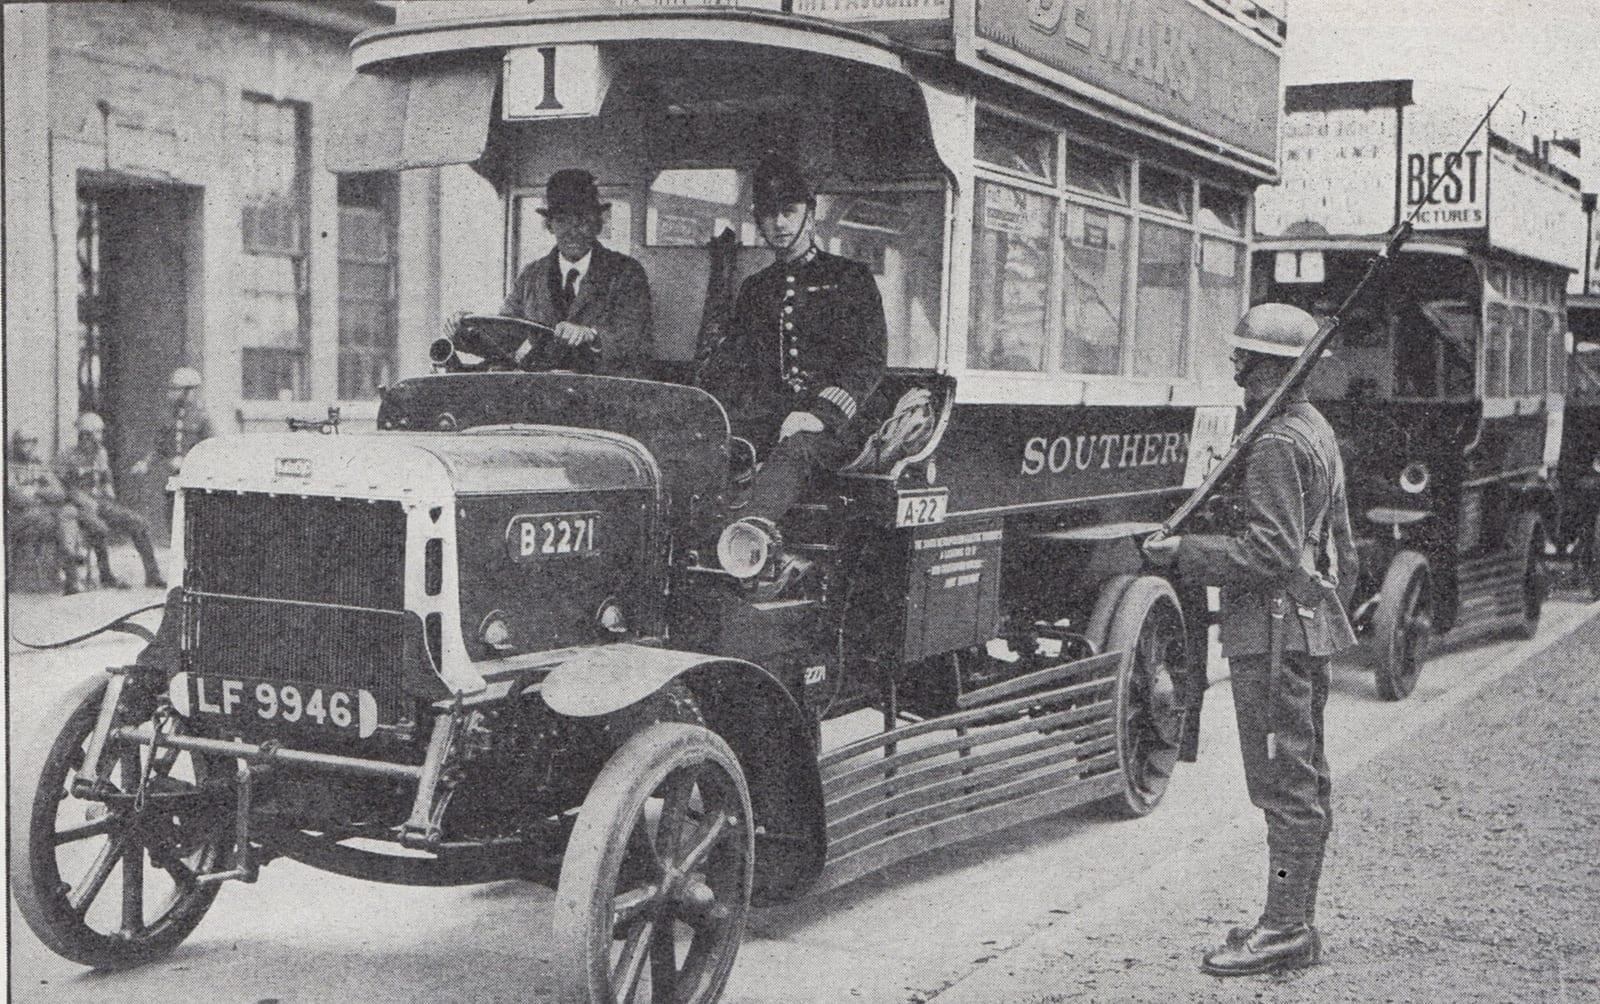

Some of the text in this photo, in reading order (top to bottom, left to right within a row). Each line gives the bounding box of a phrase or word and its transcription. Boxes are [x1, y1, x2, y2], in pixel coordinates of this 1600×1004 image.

[1407, 150, 1482, 205] BEST
[904, 498, 937, 523] A-22
[197, 677, 352, 727] LF 9946
